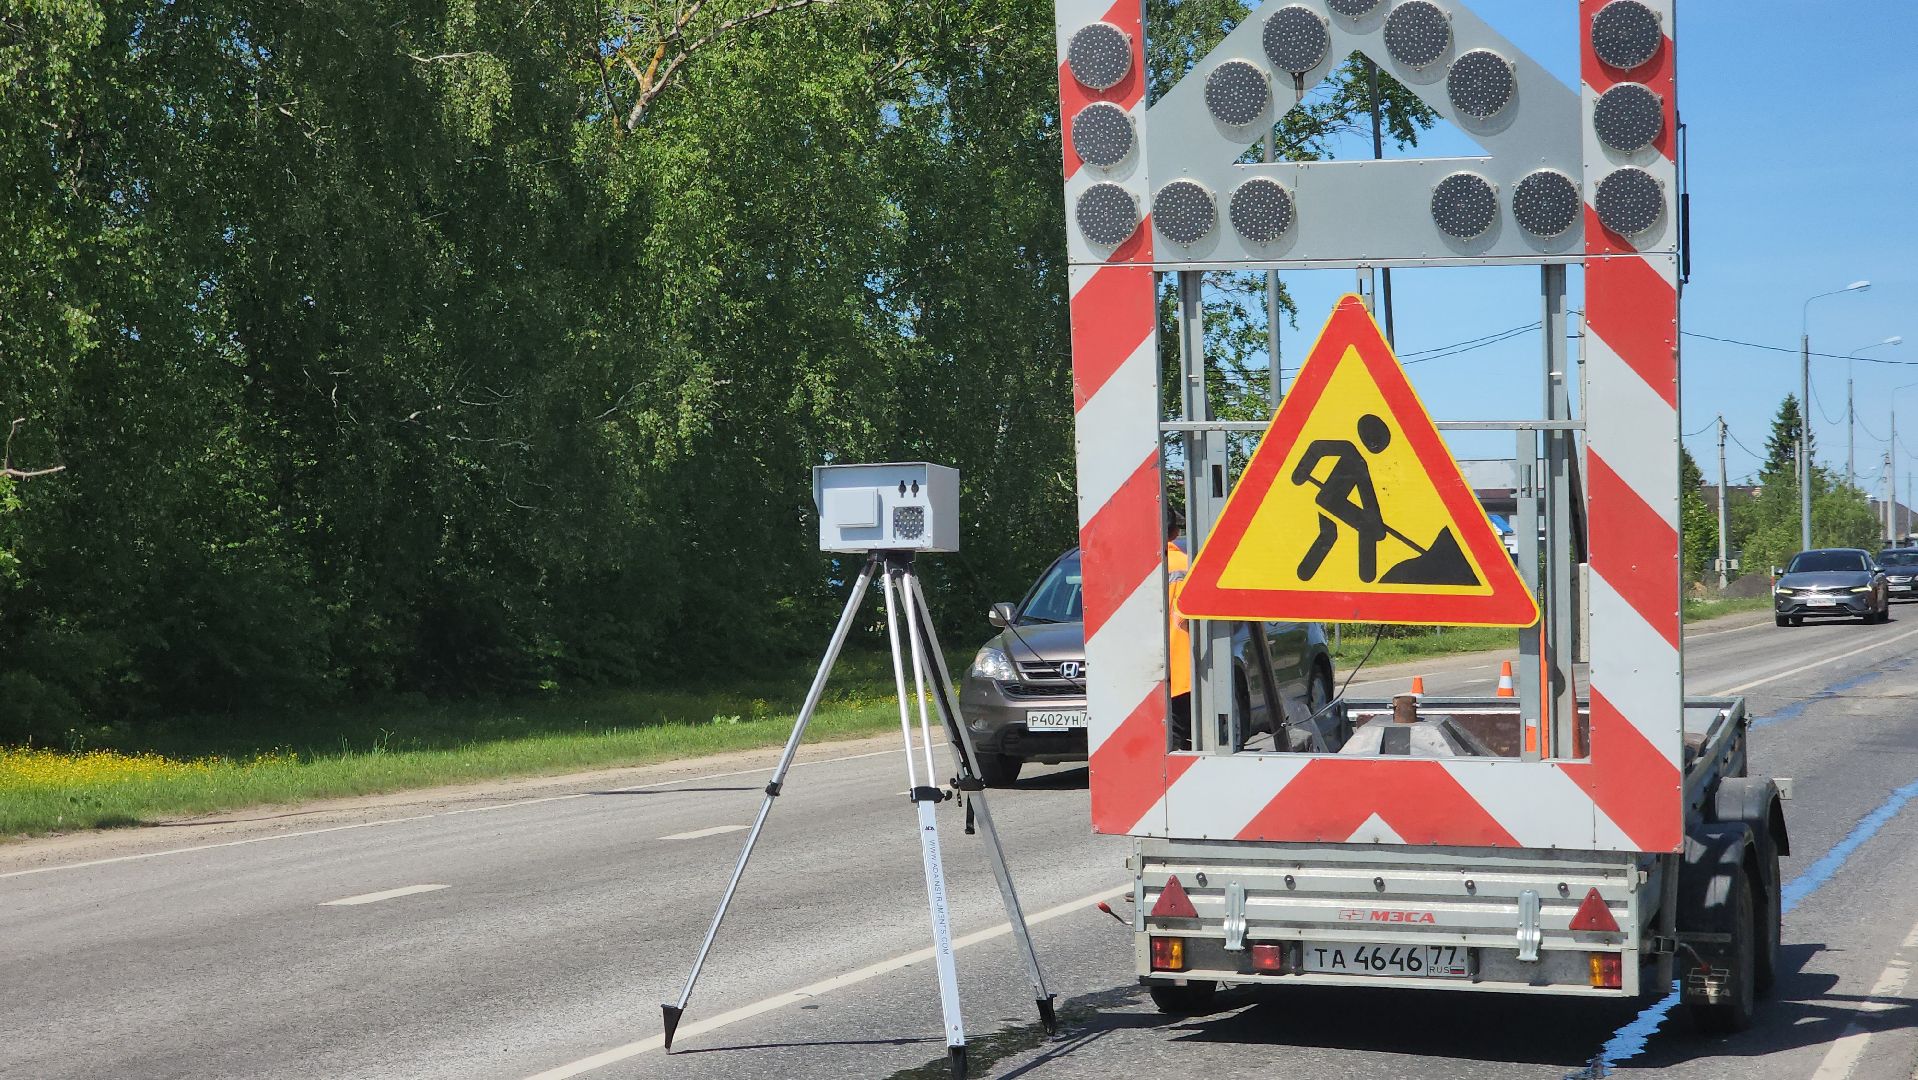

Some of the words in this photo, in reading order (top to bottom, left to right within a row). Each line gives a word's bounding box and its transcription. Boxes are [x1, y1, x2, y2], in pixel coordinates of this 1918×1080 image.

[1031, 713, 1079, 726] Р402УН
[1370, 910, 1436, 924] МЗСА
[1314, 948, 1347, 969] ТА
[1353, 946, 1423, 972] 4646
[1430, 946, 1457, 965] 77
[1429, 966, 1450, 974] RUS
